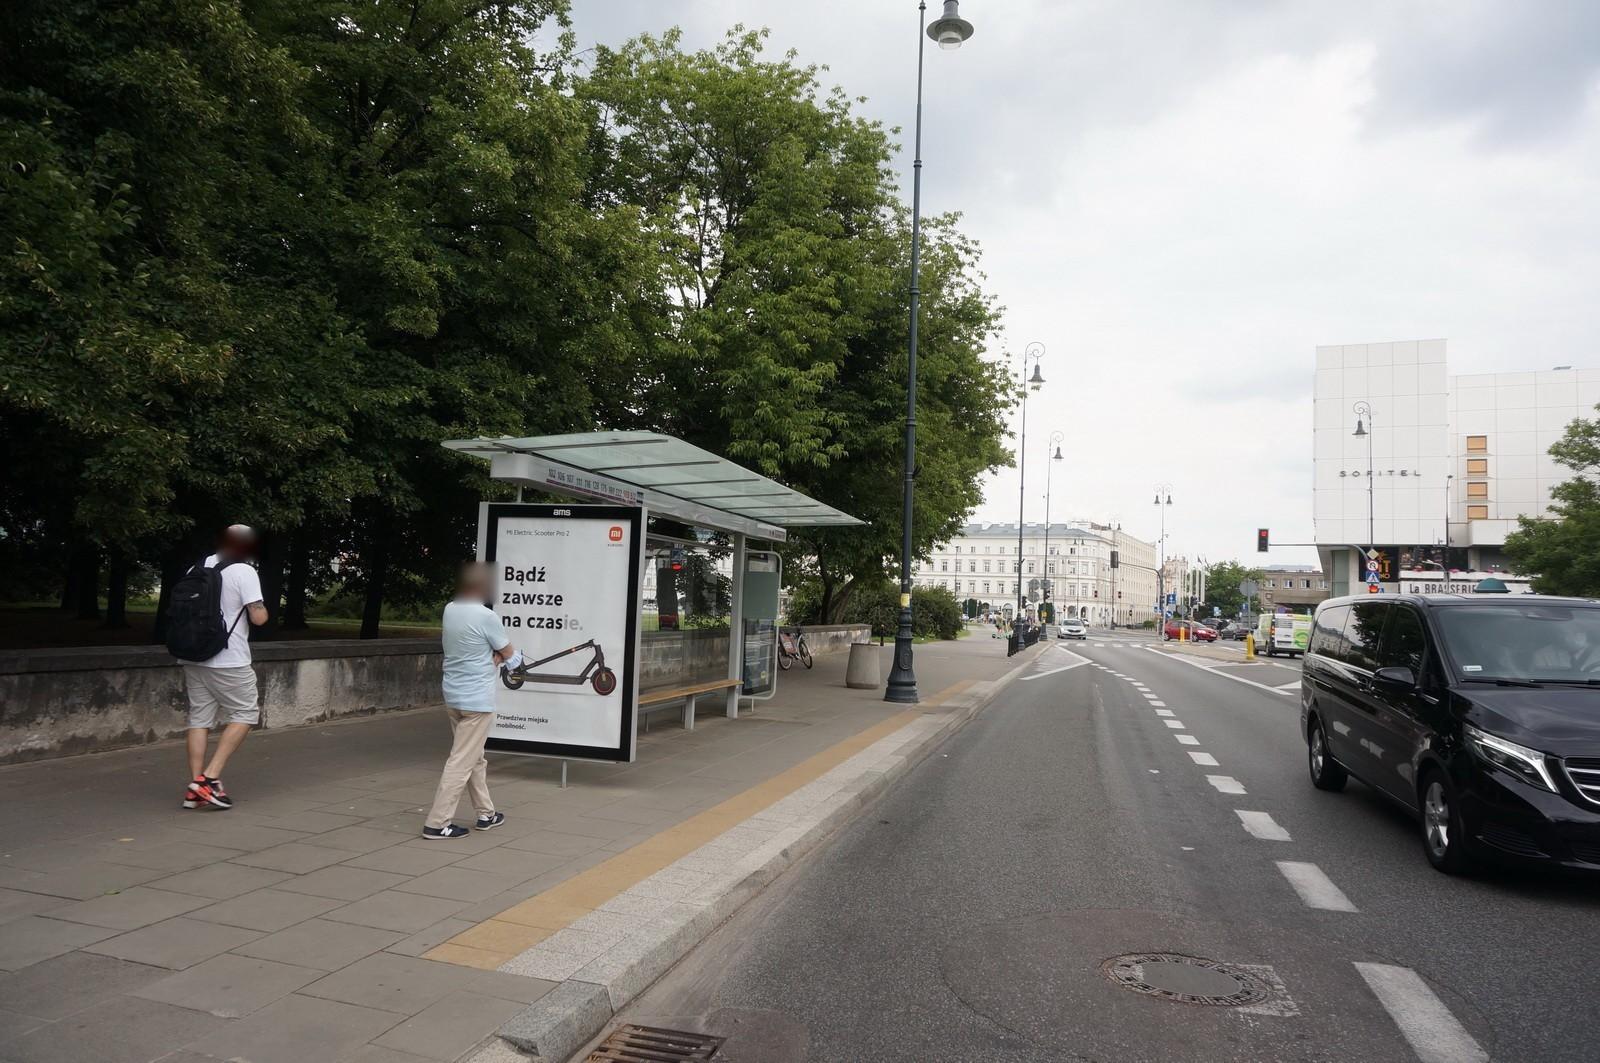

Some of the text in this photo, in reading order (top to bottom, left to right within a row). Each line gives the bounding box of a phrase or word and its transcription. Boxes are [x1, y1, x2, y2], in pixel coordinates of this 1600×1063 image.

[553, 508, 571, 516] ams
[504, 566, 546, 586] Bądź
[1409, 583, 1420, 594] La
[502, 592, 563, 606] zawsze
[502, 614, 583, 631] na czasie.
[496, 713, 549, 724] Prawdziwa miejska
